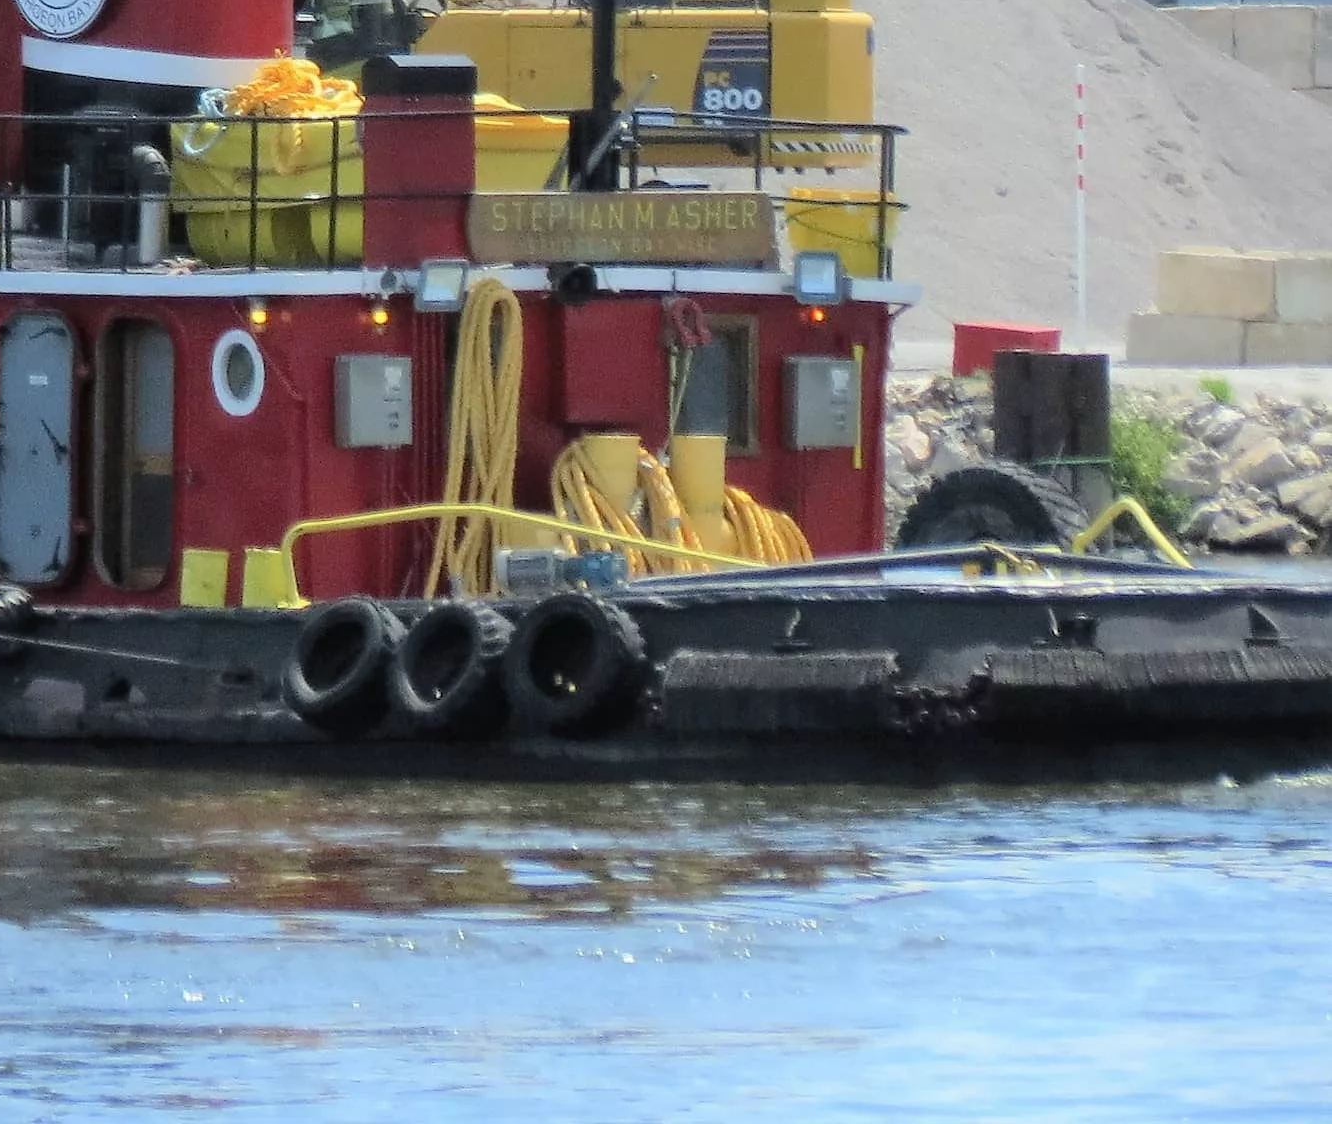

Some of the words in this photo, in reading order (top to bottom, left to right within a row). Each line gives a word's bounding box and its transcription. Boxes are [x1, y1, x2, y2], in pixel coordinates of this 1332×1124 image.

[703, 88, 763, 111] 800
[492, 200, 624, 232] STEPHAN
[666, 199, 758, 230] ASHER
